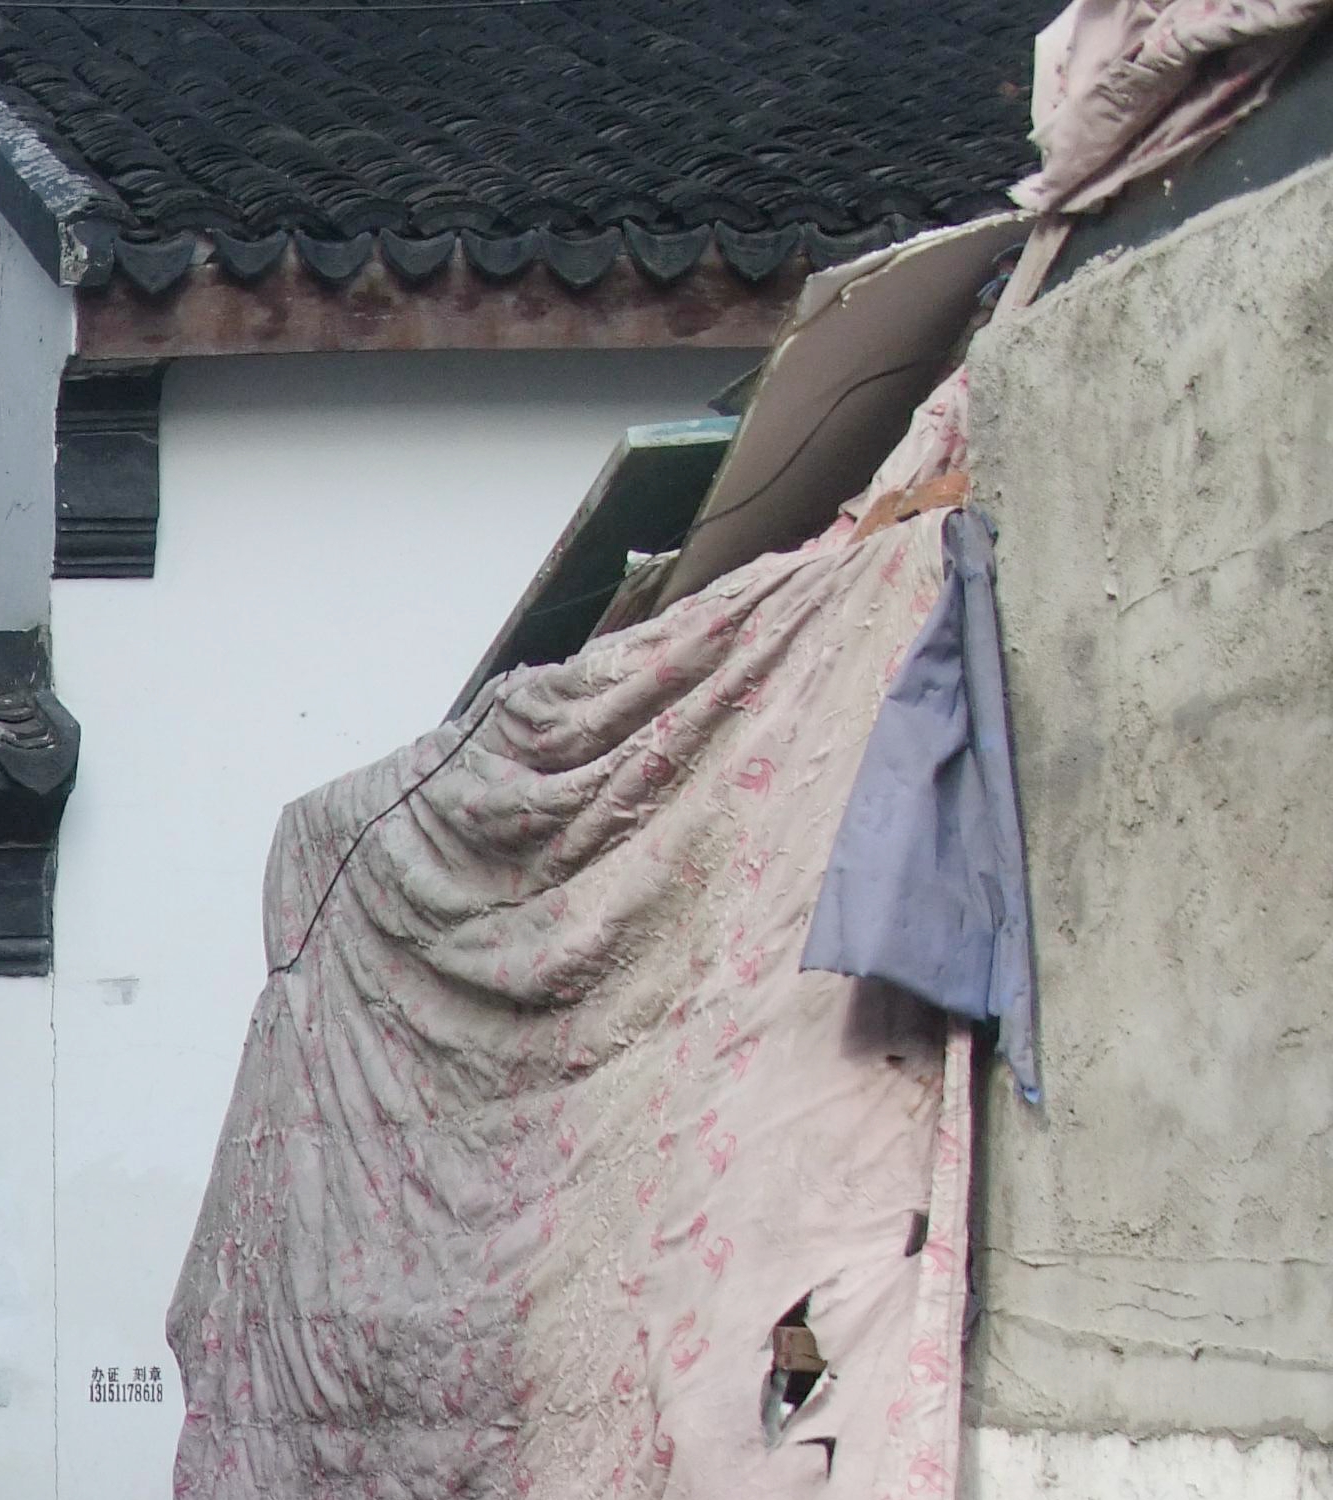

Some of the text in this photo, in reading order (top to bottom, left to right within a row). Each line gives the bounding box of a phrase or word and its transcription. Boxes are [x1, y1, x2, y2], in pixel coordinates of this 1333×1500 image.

[90, 1366, 162, 1382] 办证 刻章
[88, 1382, 164, 1403] 13151178618
